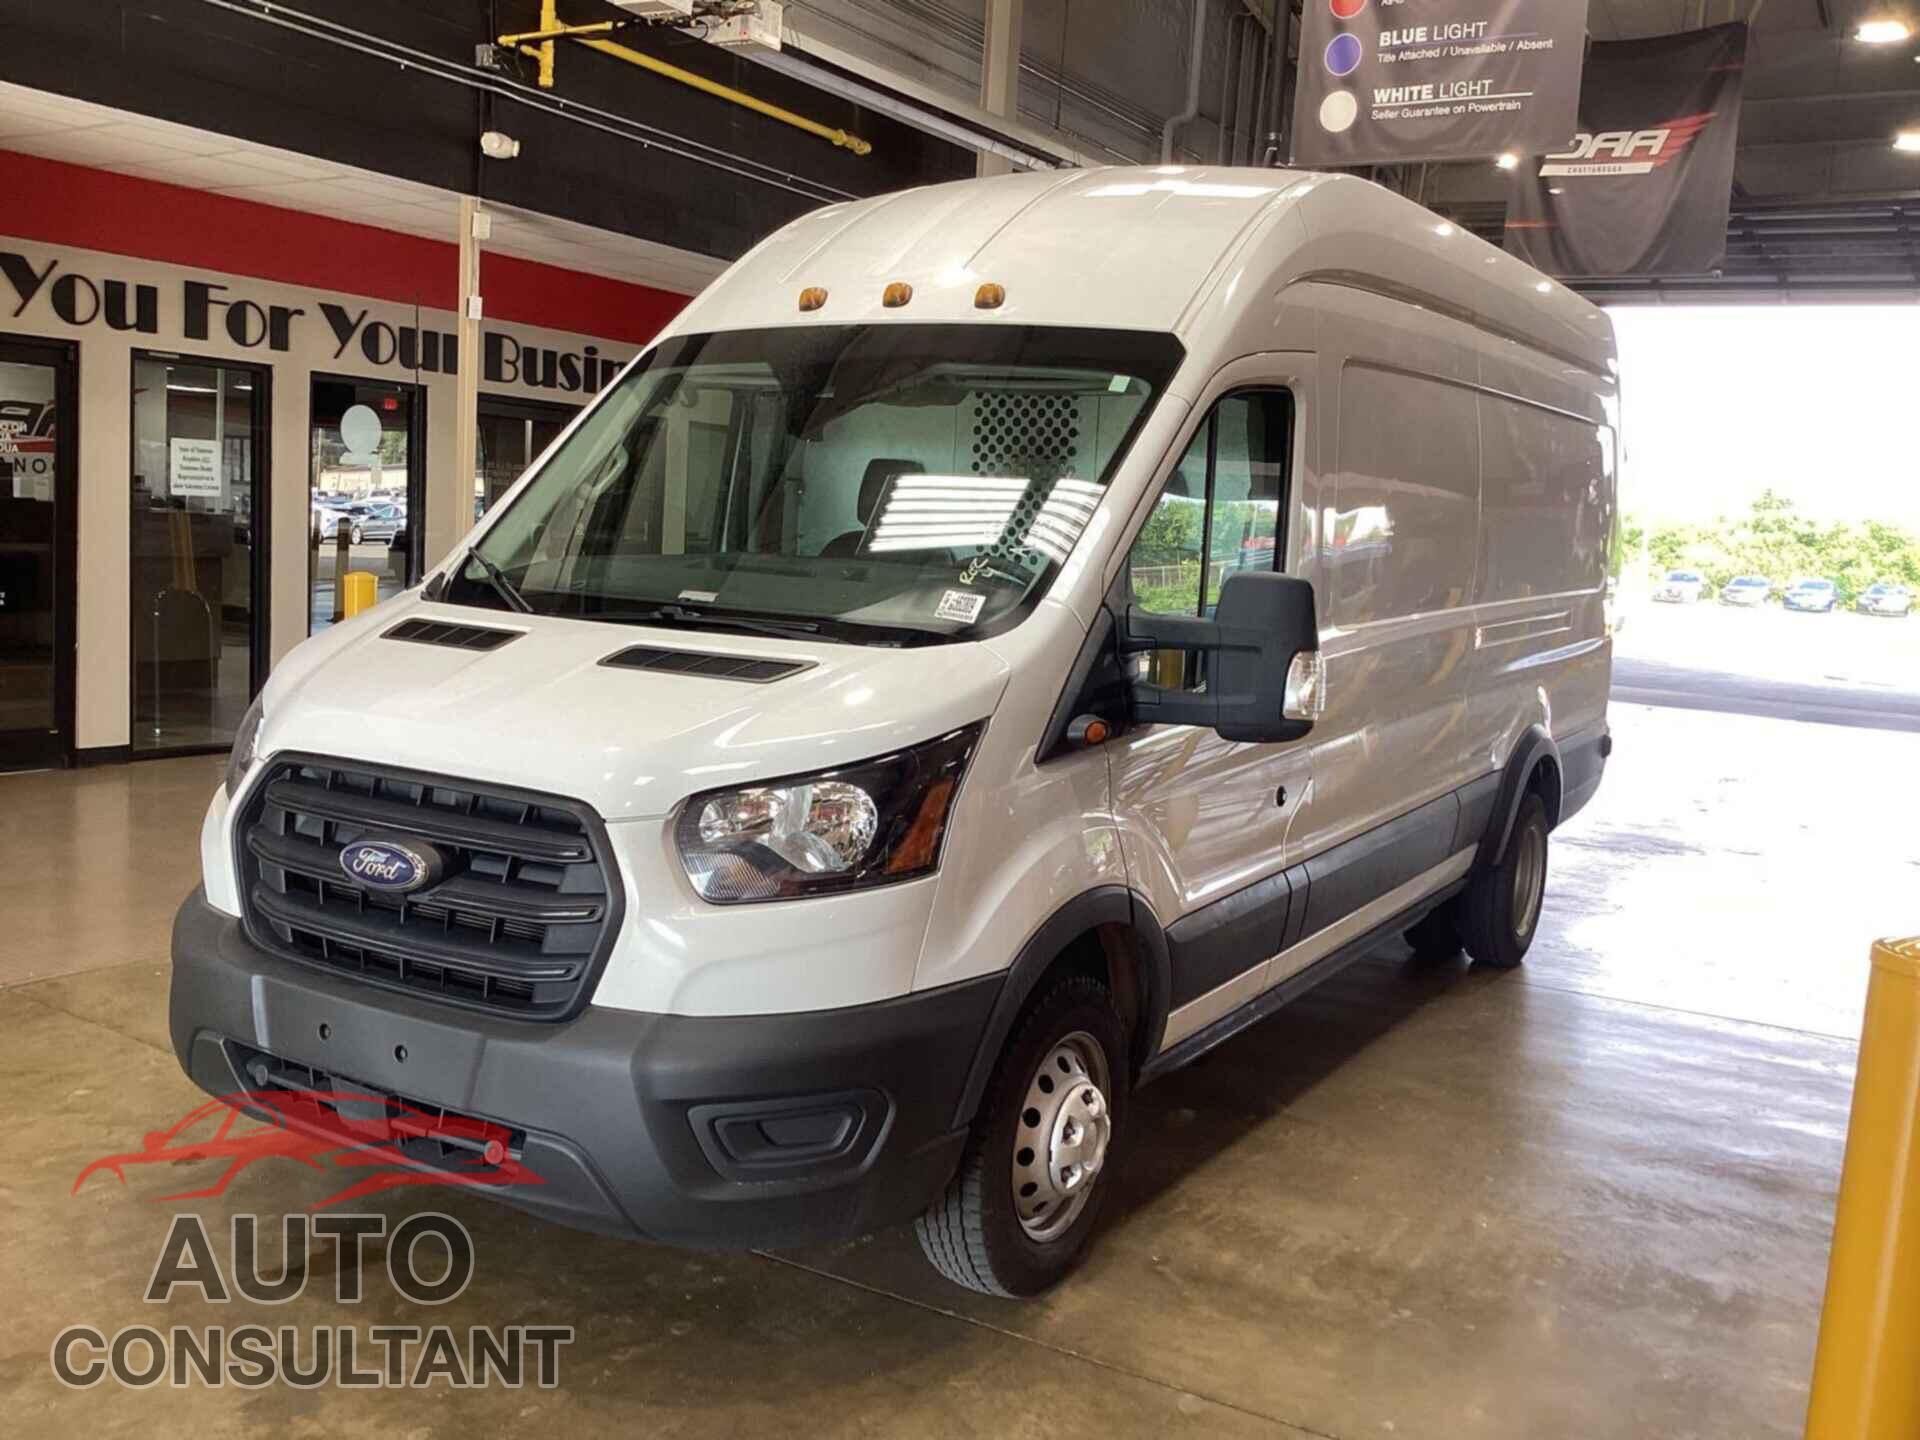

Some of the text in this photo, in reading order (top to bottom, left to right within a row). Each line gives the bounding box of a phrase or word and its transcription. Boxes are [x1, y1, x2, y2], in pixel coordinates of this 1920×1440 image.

[1379, 21, 1488, 47] BLUE LIGHT
[1377, 52, 1397, 63] Title
[1398, 47, 1441, 62] Attached
[1450, 43, 1507, 57] Unavailable
[1516, 38, 1554, 51] Absent
[1373, 79, 1494, 104] WHITE LIGHT
[1371, 99, 1522, 121] Seller Guarantee on Powertrain
[0, 251, 158, 334] You
[183, 280, 305, 352] For
[352, 847, 408, 881] Ford
